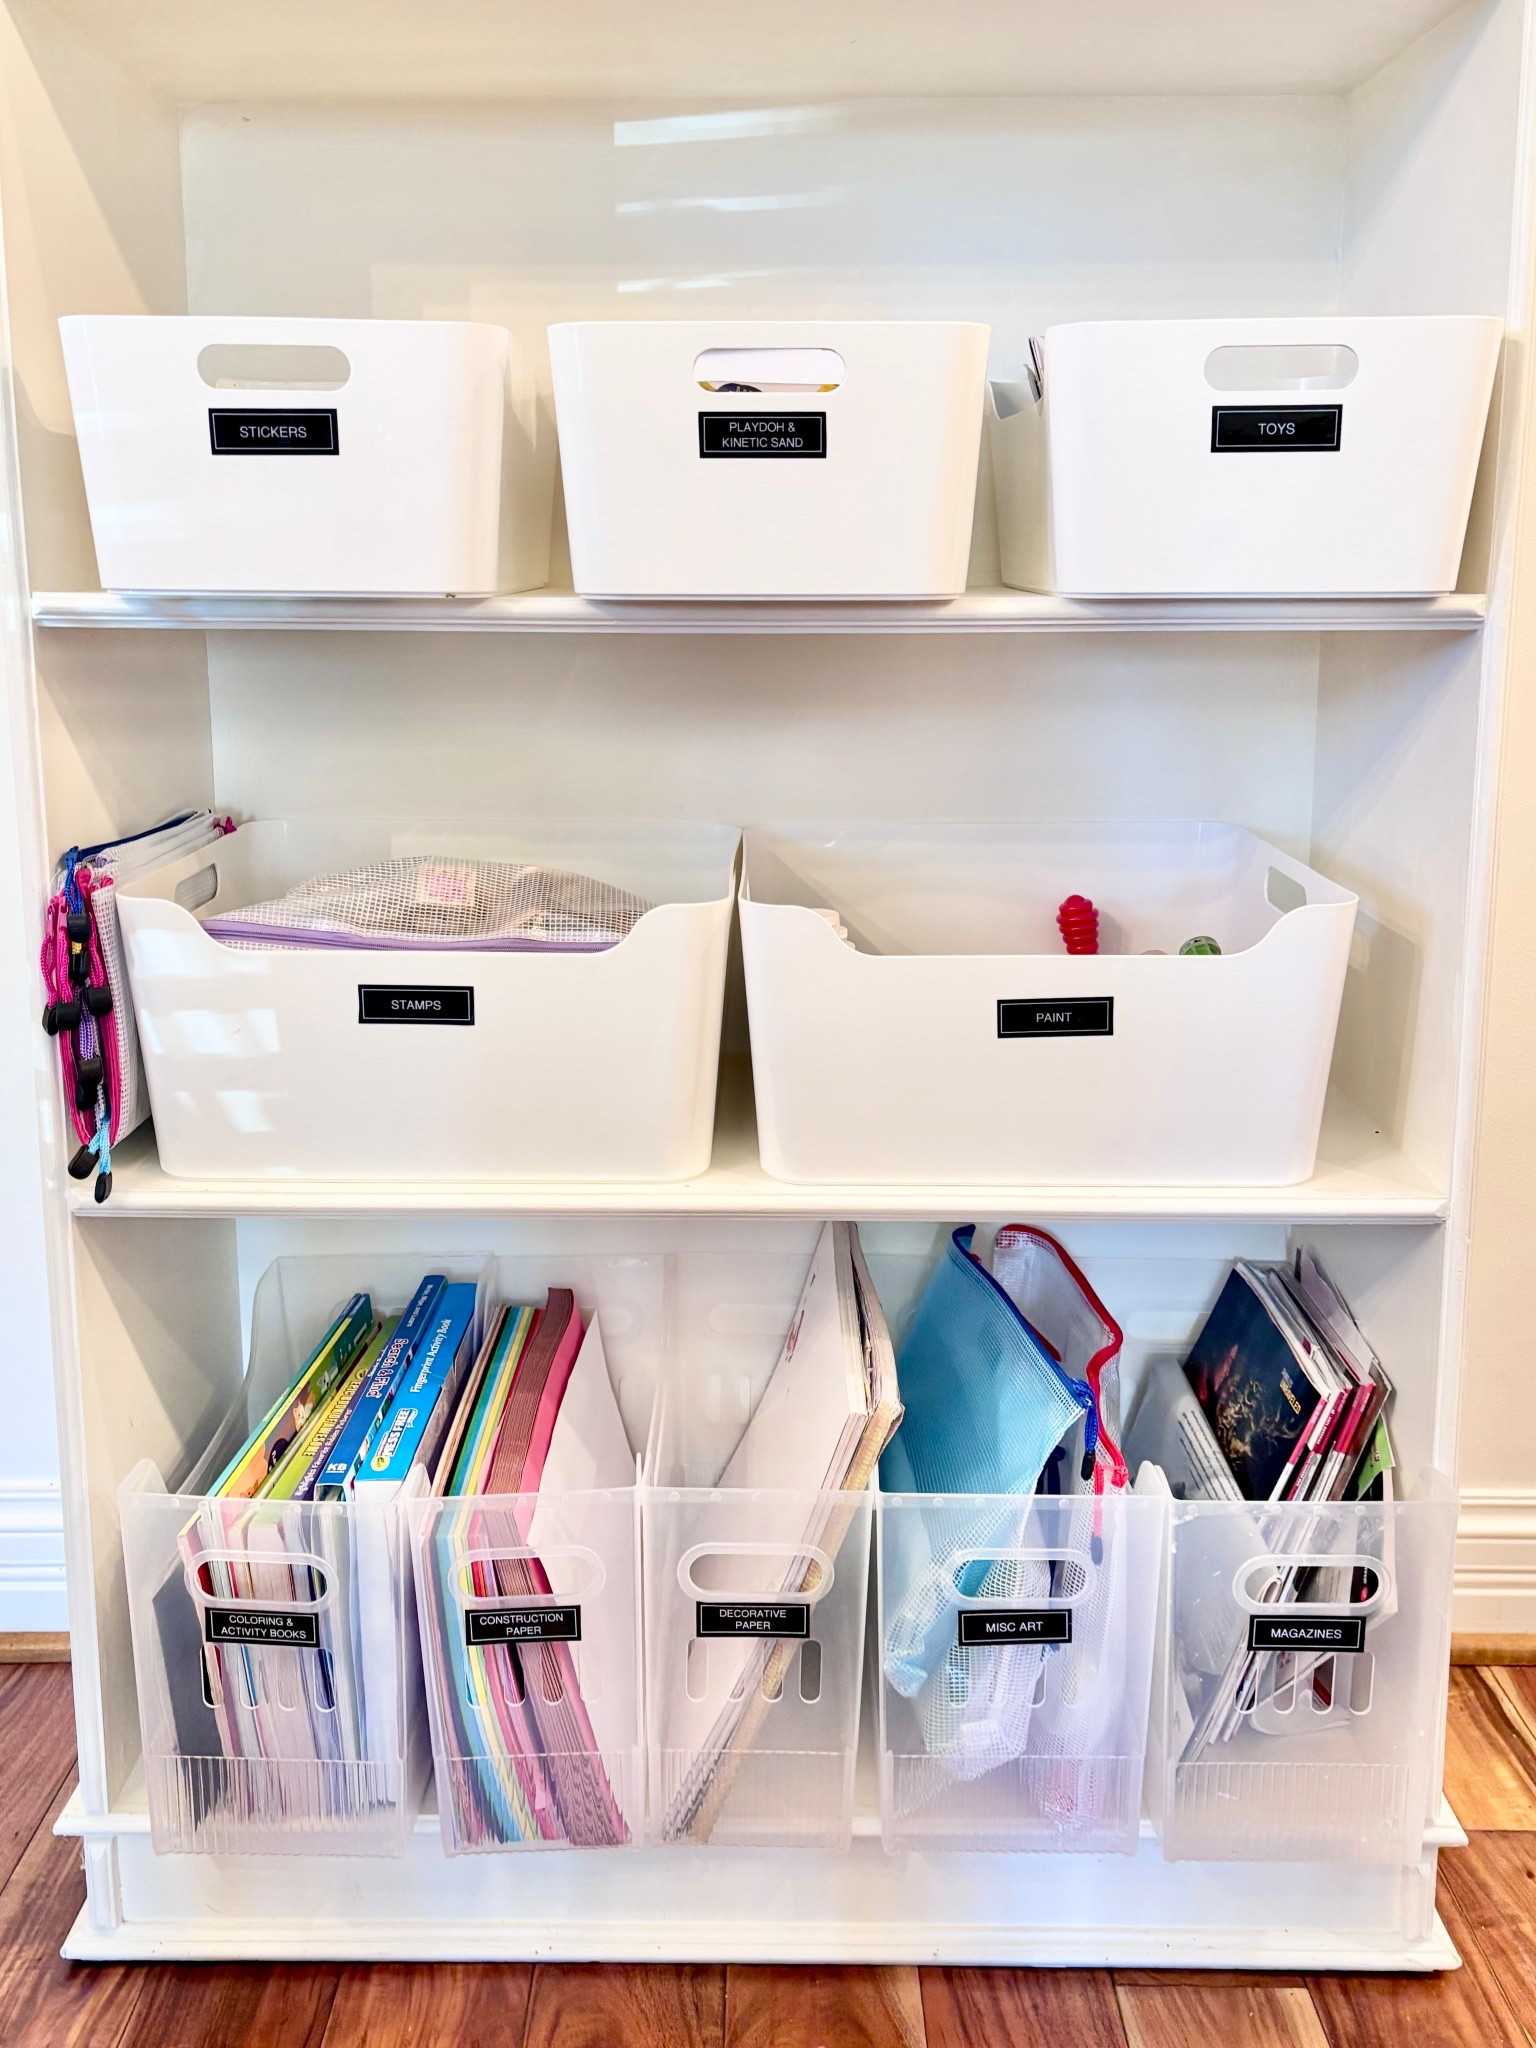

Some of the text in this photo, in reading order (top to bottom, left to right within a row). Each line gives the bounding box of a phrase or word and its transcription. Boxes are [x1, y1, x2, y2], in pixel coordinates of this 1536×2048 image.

[239, 425, 307, 438] STICKERS
[729, 422, 796, 432] PLAYDOH &
[1258, 422, 1296, 435] TOYS
[722, 437, 804, 448] KINETIC SAND
[391, 999, 442, 1011] STAMPS
[1036, 1012, 1073, 1024] PAINT
[436, 1319, 452, 1336] Book
[430, 1333, 447, 1357] Activity
[382, 1338, 409, 1369] Search
[378, 1368, 394, 1378] &
[410, 1356, 433, 1393] Fingerprint
[343, 1381, 361, 1395] EPIC
[366, 1376, 390, 1398] Find
[302, 1422, 337, 1456] AWESOME
[382, 1431, 400, 1456] MESS
[392, 1409, 411, 1432] FREE
[327, 1463, 348, 1471] KB
[480, 1613, 563, 1626] CONSTRUCTION
[719, 1609, 786, 1618] DECORATIVE
[229, 1614, 293, 1627] COLORING &
[735, 1621, 770, 1630] PAPER
[986, 1621, 1043, 1633] MISC ART
[221, 1626, 306, 1639] ACTIVITY BOOKS
[506, 1626, 541, 1636] PAPER
[1271, 1628, 1342, 1639] MAGAZINES
